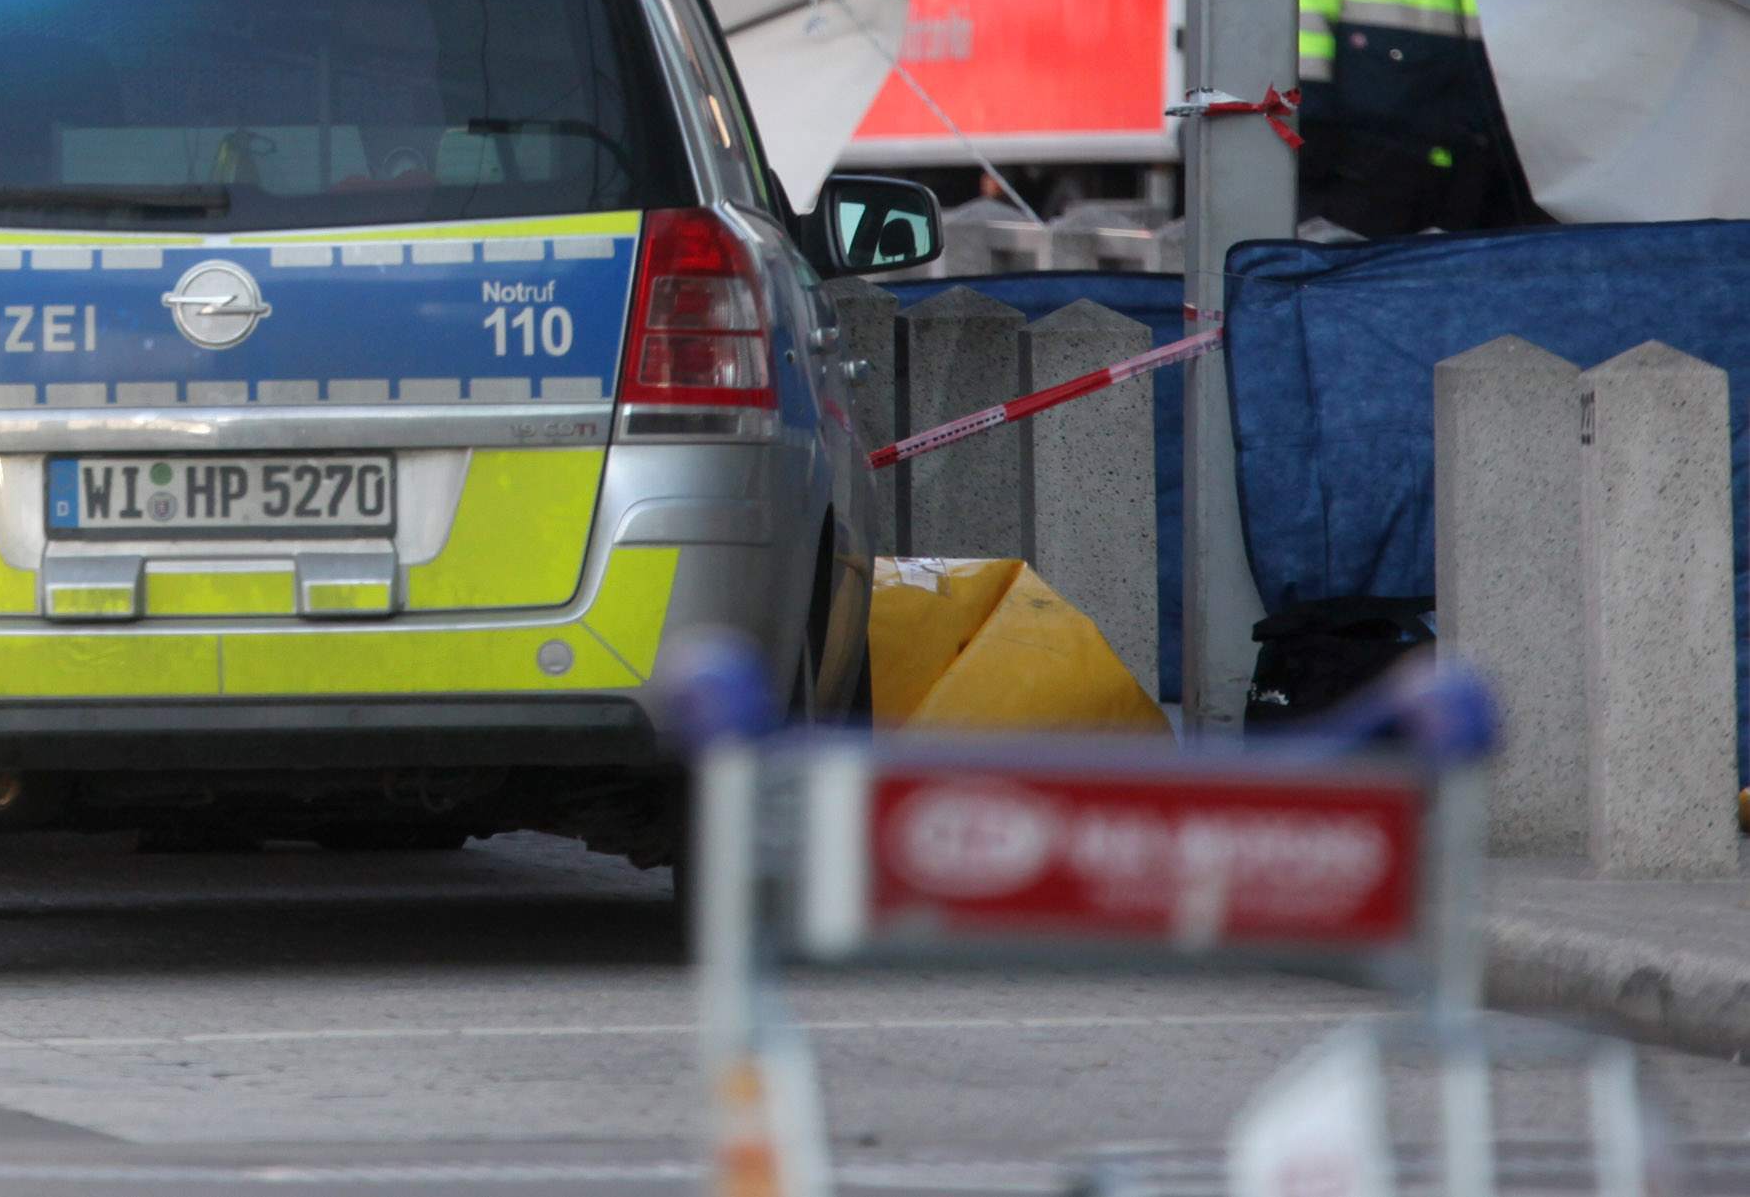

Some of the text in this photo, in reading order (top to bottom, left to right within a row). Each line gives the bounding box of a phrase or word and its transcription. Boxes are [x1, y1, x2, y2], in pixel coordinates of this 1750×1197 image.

[482, 281, 556, 303] Notruf
[483, 306, 573, 356] 110
[83, 464, 386, 519] WI HP 5270
